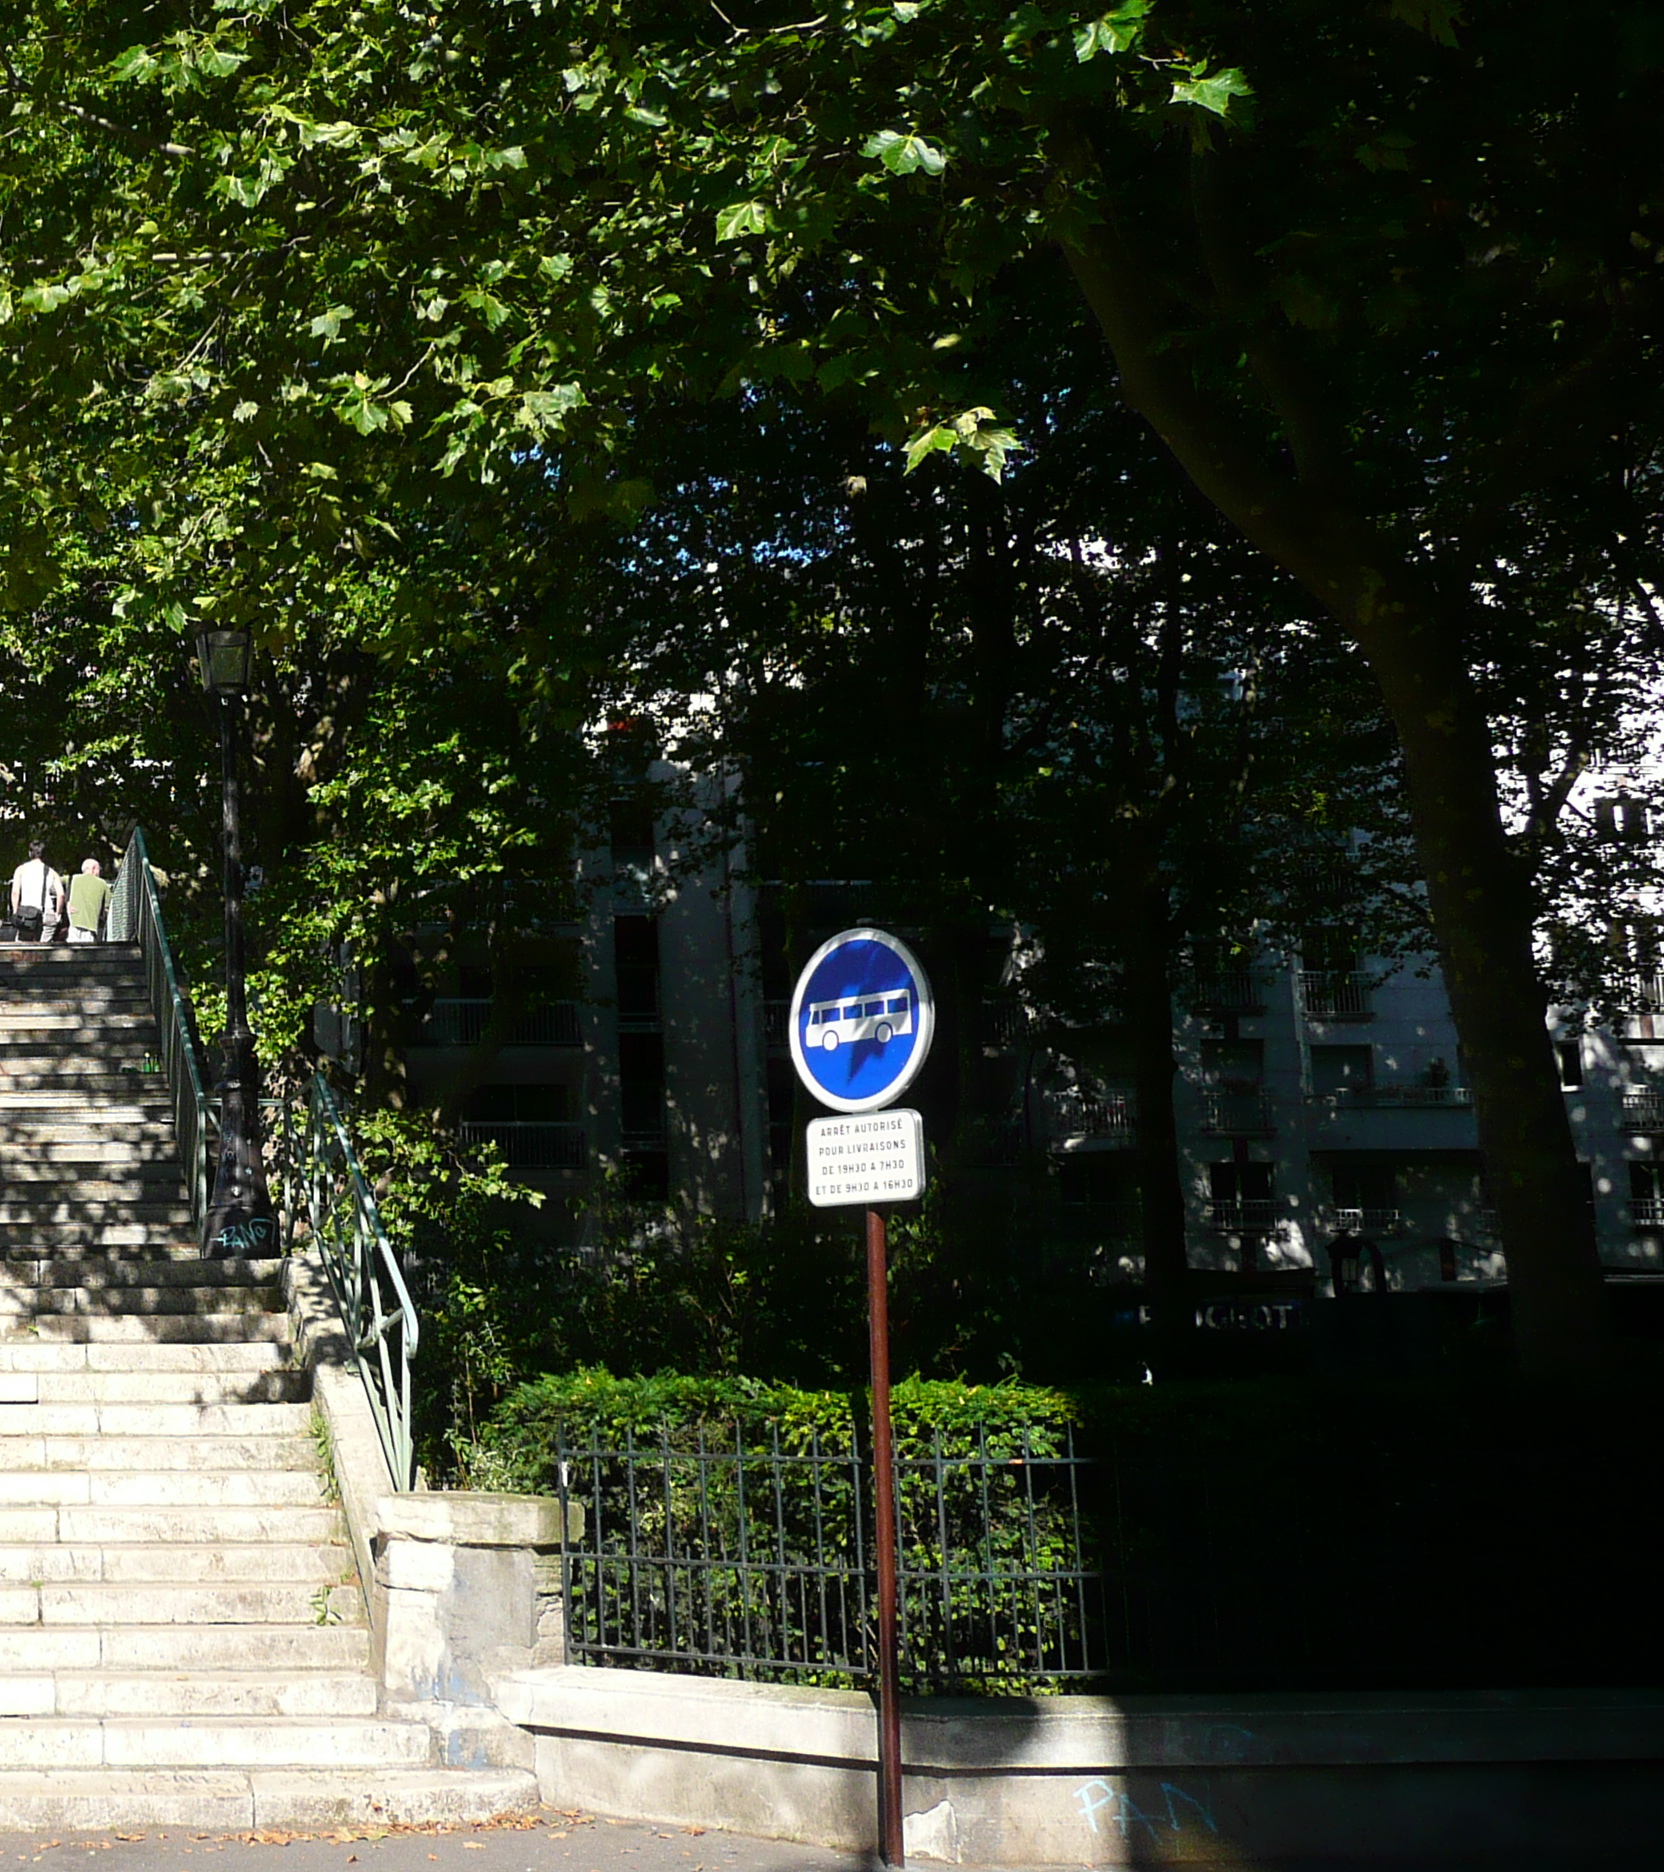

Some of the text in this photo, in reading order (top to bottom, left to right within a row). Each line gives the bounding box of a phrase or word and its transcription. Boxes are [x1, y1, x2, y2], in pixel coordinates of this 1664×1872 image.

[821, 1118, 902, 1136] ARRÊT AUTORISÉ
[819, 1139, 905, 1156] POUR LIVRAISONS
[822, 1165, 835, 1176] DE
[837, 1162, 867, 1175] 19H30
[879, 1159, 905, 1171] 7H30
[815, 1185, 827, 1196] ET
[830, 1184, 842, 1195] DE
[845, 1181, 870, 1194] 9H30
[882, 1178, 913, 1190] 16H30
